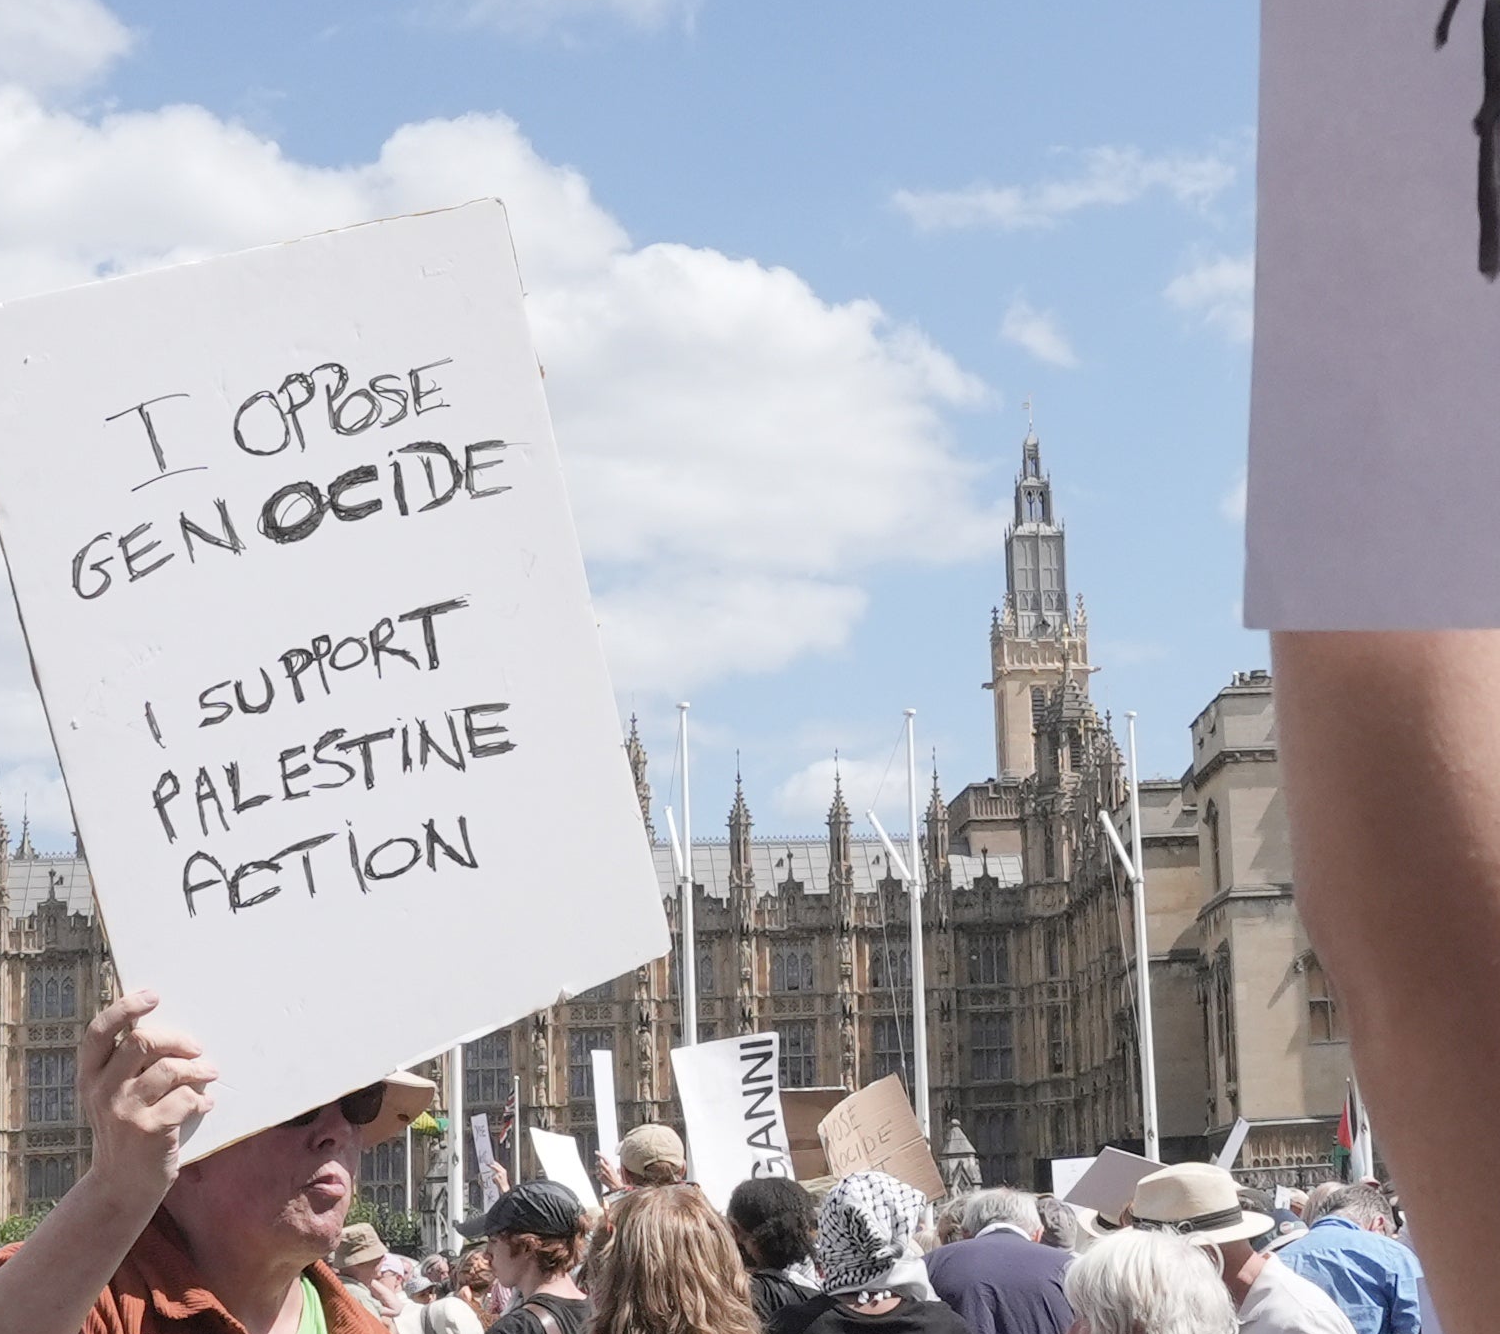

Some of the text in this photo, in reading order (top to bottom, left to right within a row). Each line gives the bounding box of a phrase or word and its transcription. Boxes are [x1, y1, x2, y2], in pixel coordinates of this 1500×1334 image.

[105, 357, 452, 491] I OPPOSE
[71, 440, 530, 599] GENOCIDE
[144, 594, 469, 748] I SUPPORT
[152, 702, 516, 843] PALESTINE
[831, 1119, 892, 1170] OCIDE
